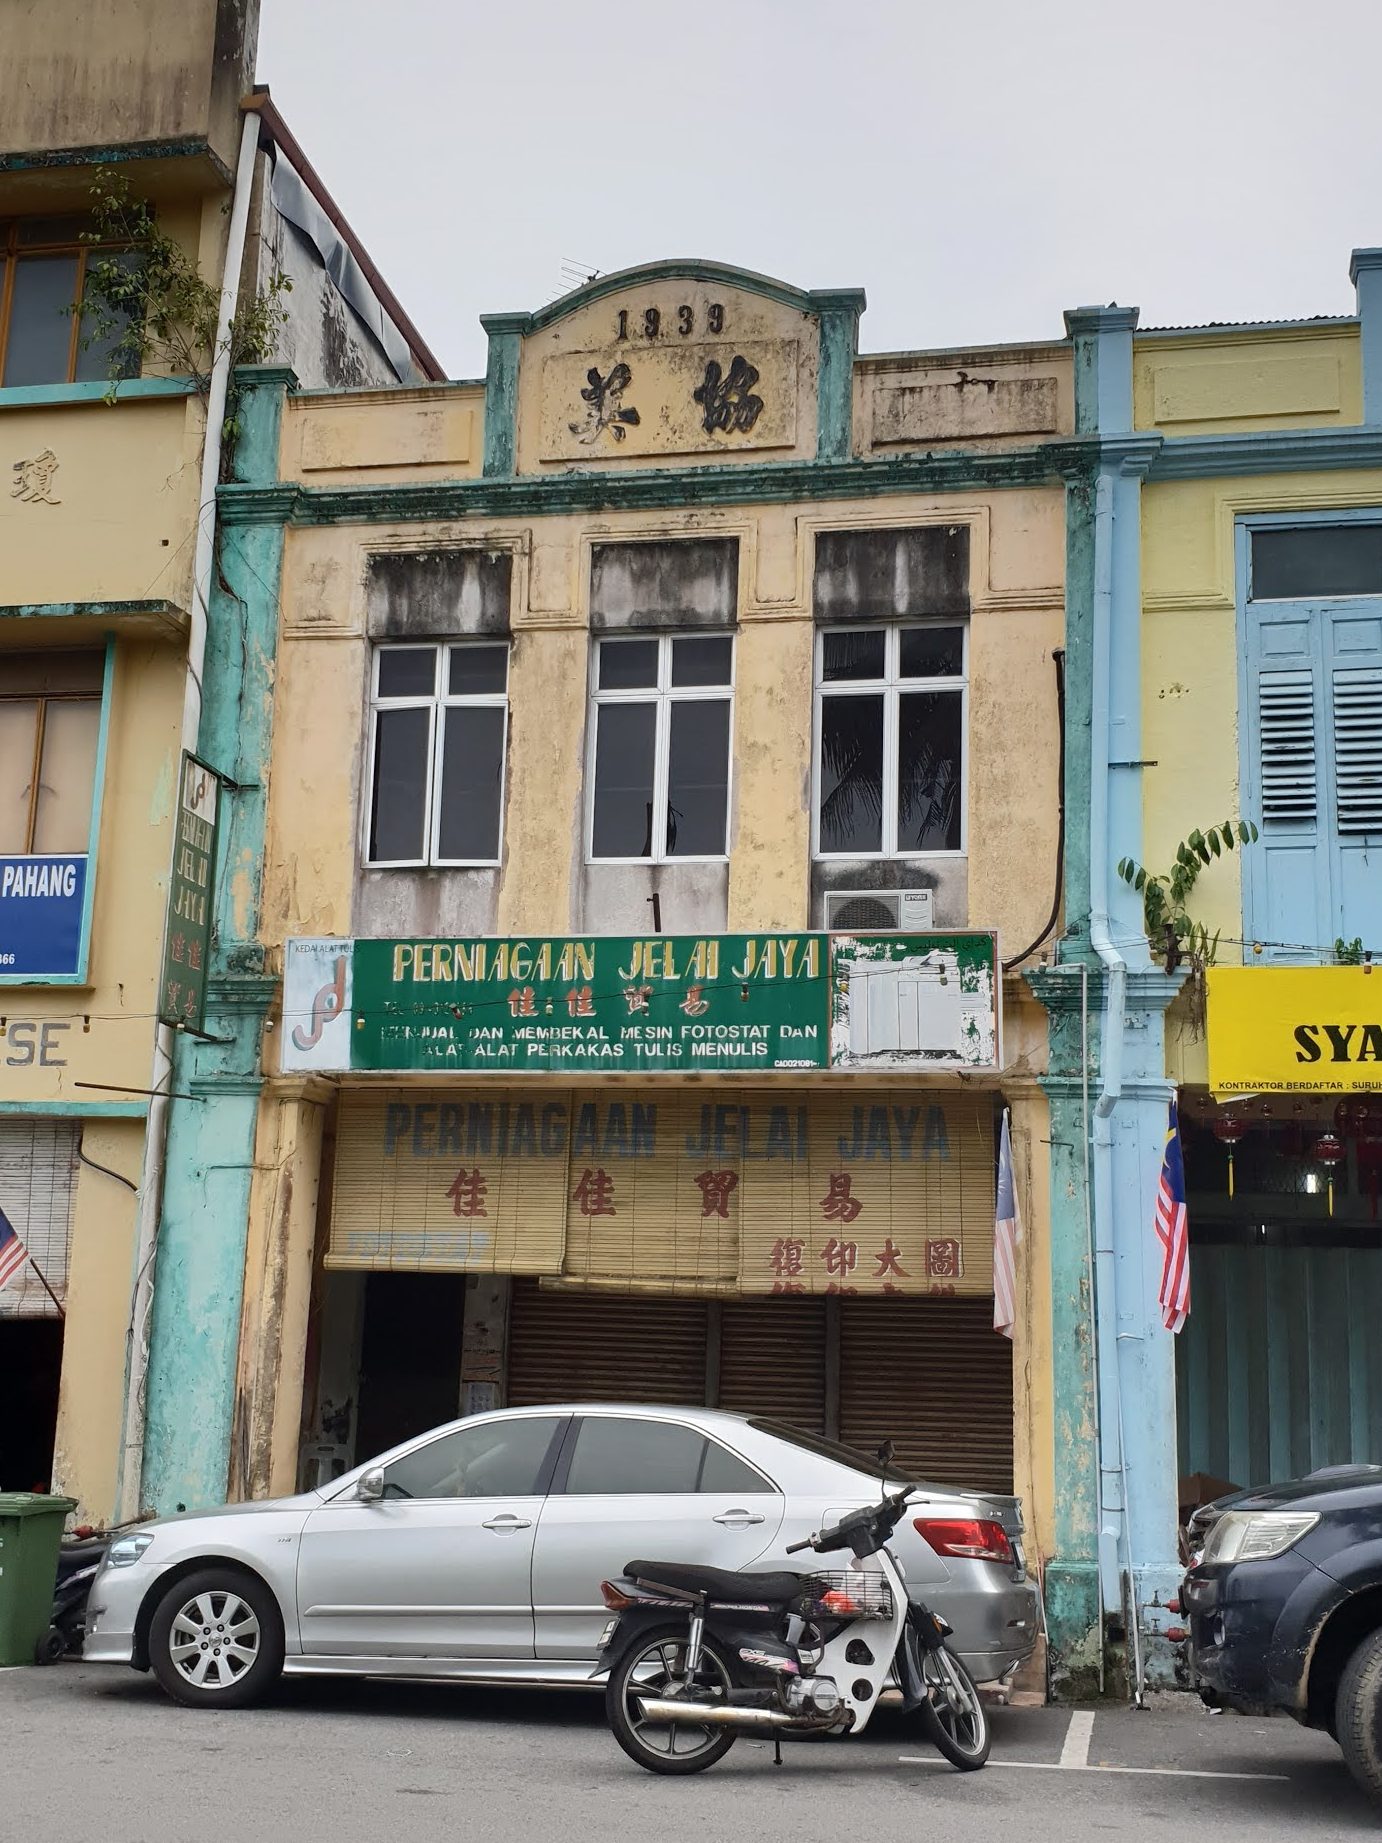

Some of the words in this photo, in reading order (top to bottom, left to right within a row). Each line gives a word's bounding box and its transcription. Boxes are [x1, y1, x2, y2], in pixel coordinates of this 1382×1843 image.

[617, 303, 726, 341] 1939
[2, 864, 77, 898] PAHANG
[295, 944, 317, 953] KEDAI
[318, 944, 337, 953] ALAT
[392, 942, 597, 983] PERNIAGAAN
[617, 939, 720, 981] JELAI
[731, 939, 820, 981] JAYA
[511, 1026, 610, 1040] MEMBEKAL
[620, 1025, 673, 1040] MESIN
[681, 1025, 772, 1040] FOTOSTAT
[780, 1024, 818, 1039] DAN
[527, 1043, 624, 1057] PERKAKAS
[634, 1042, 682, 1057] TULIS
[691, 1042, 769, 1057] MENULIS
[1218, 1081, 1284, 1090] KONTRAKTOR
[1286, 1081, 1344, 1090] BERDAFTAR
[383, 1102, 657, 1159] PERNIAGAAN
[684, 1103, 809, 1160] JELAI
[836, 1104, 951, 1160] JAYA
[445, 1168, 863, 1224] 佳佳貿易
